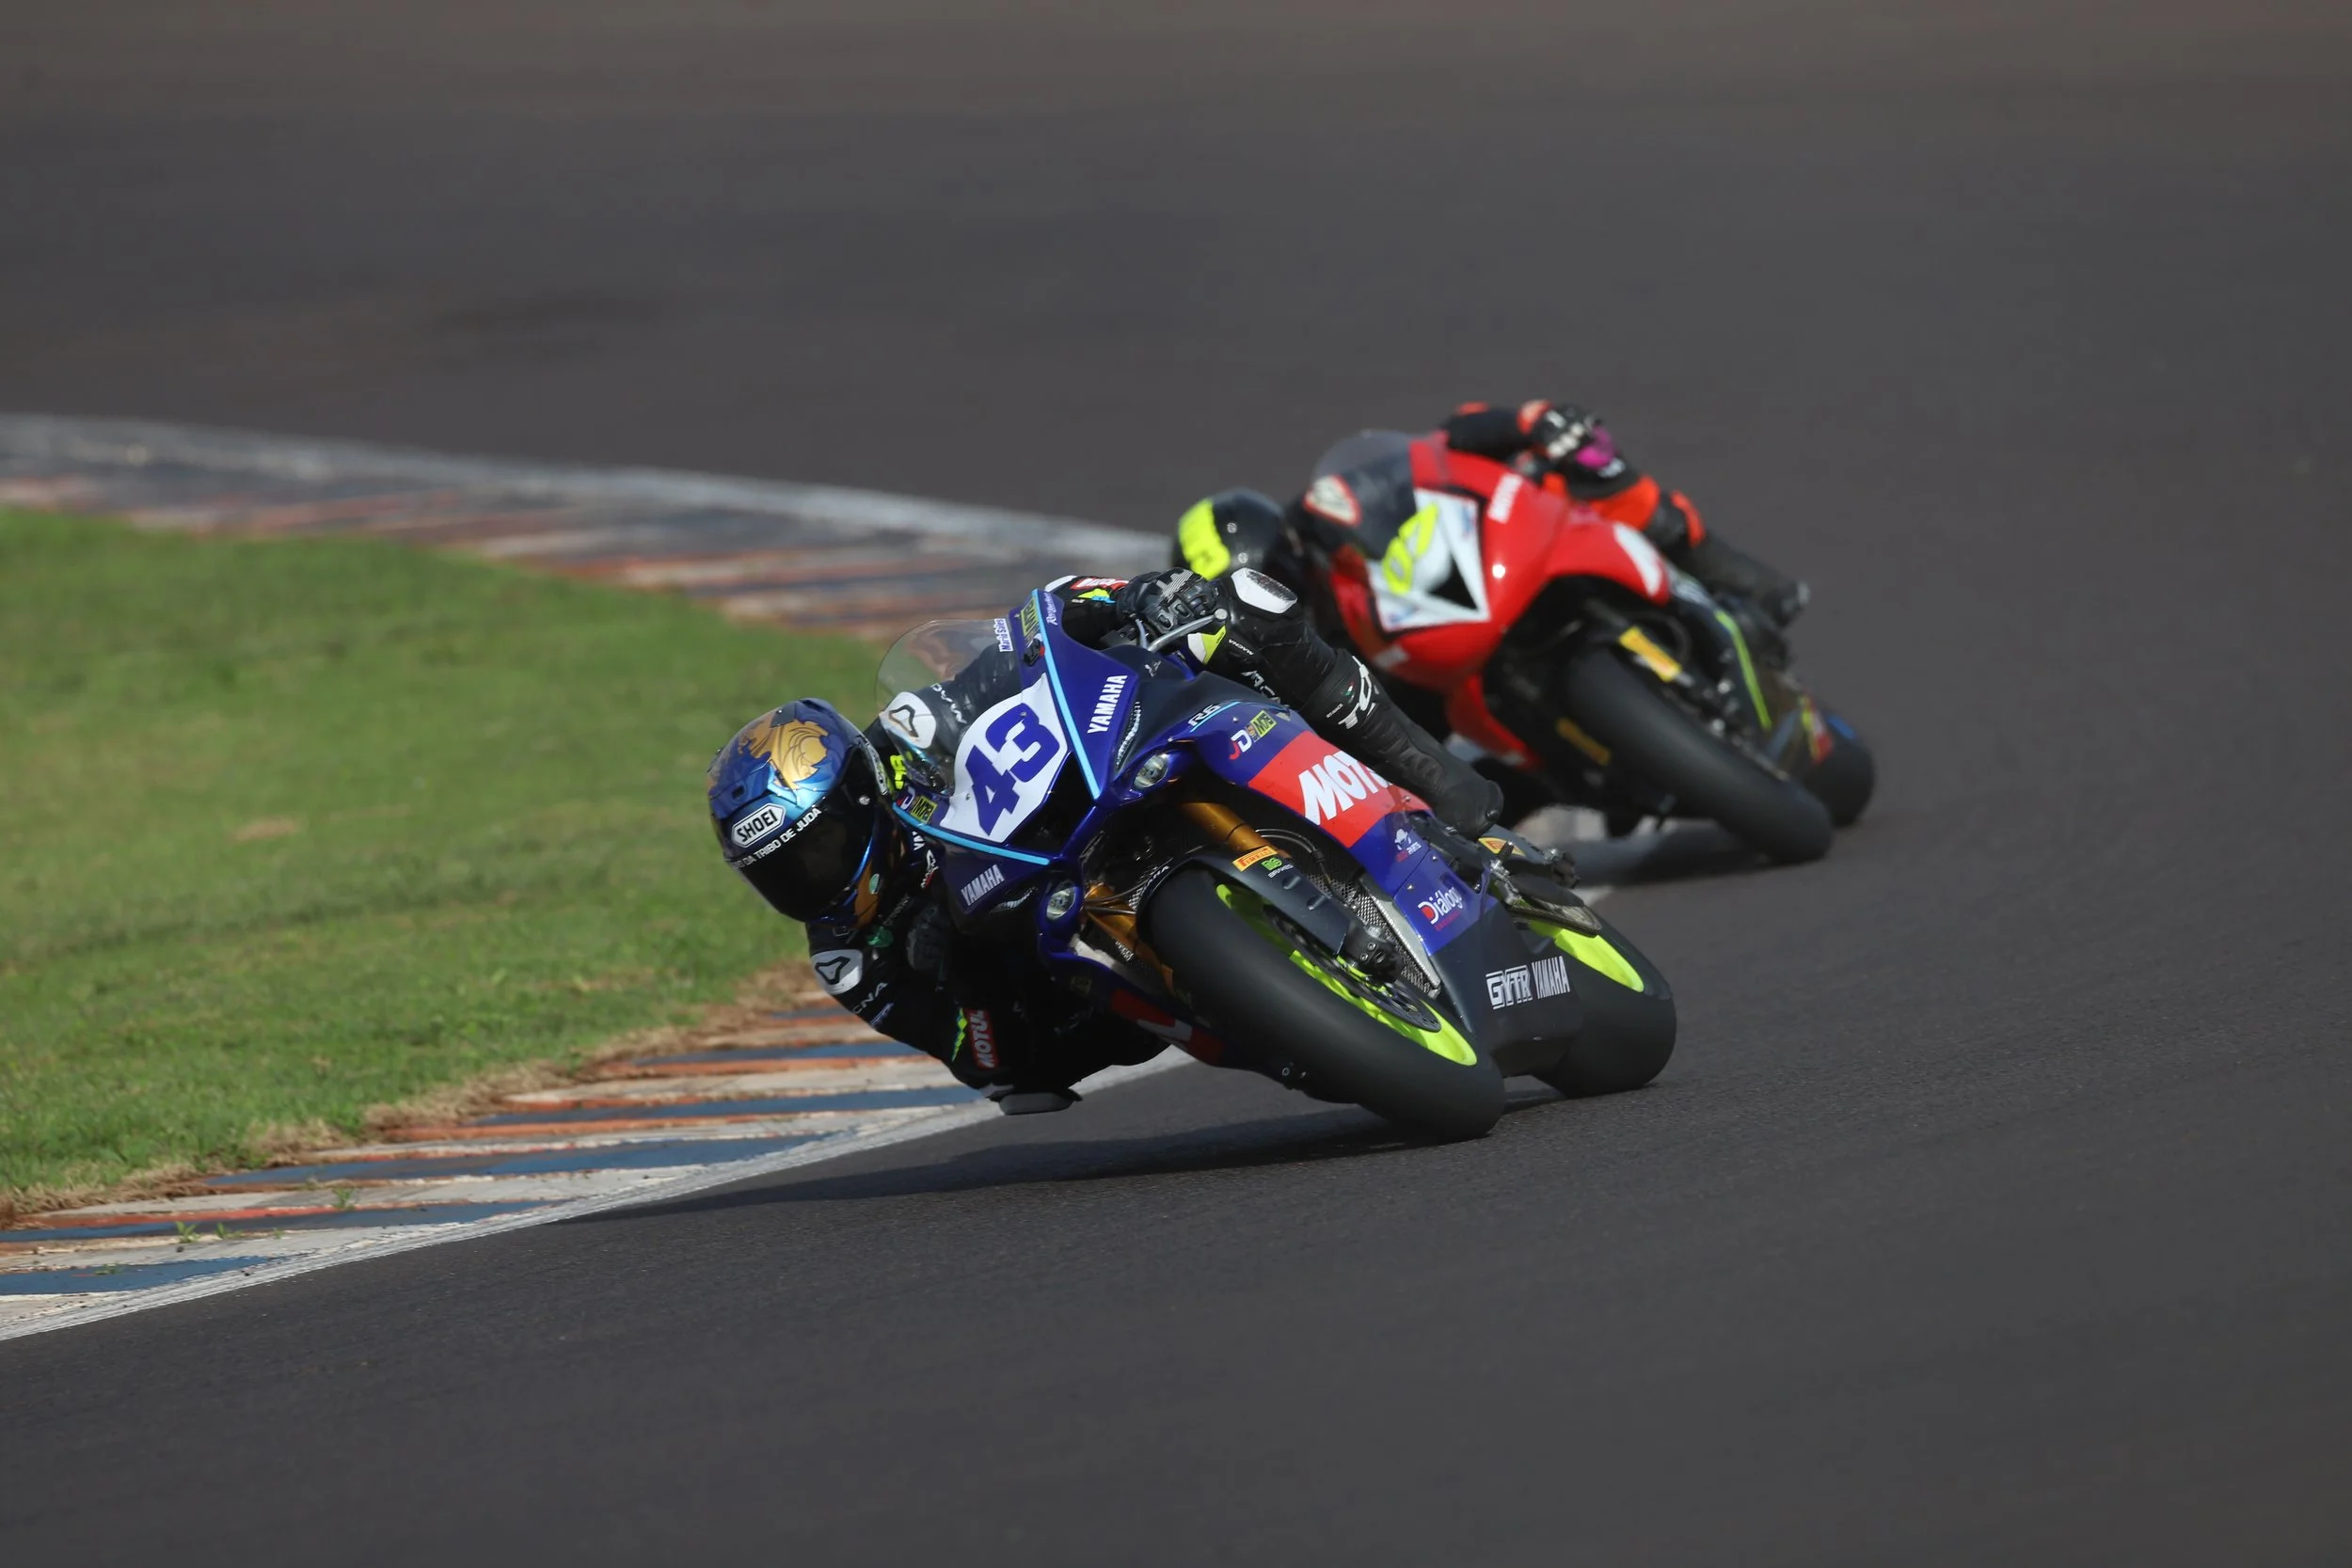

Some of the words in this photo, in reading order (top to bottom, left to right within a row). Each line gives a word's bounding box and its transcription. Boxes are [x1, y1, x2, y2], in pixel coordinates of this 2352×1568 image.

[1229, 639, 1254, 656] MACNA
[1088, 674, 1128, 734] YAMAHA
[1187, 705, 1221, 726] R6
[965, 703, 1060, 837] 43
[1298, 751, 1392, 826] MOT
[737, 809, 778, 842] SHOEI
[754, 839, 782, 859] TRIBO
[779, 828, 797, 843] DE
[961, 863, 1005, 906] YAMAHA
[1486, 964, 1533, 1010] GYTR
[1532, 955, 1570, 1000] YAMAHA
[969, 1008, 994, 1069] MOTUL
